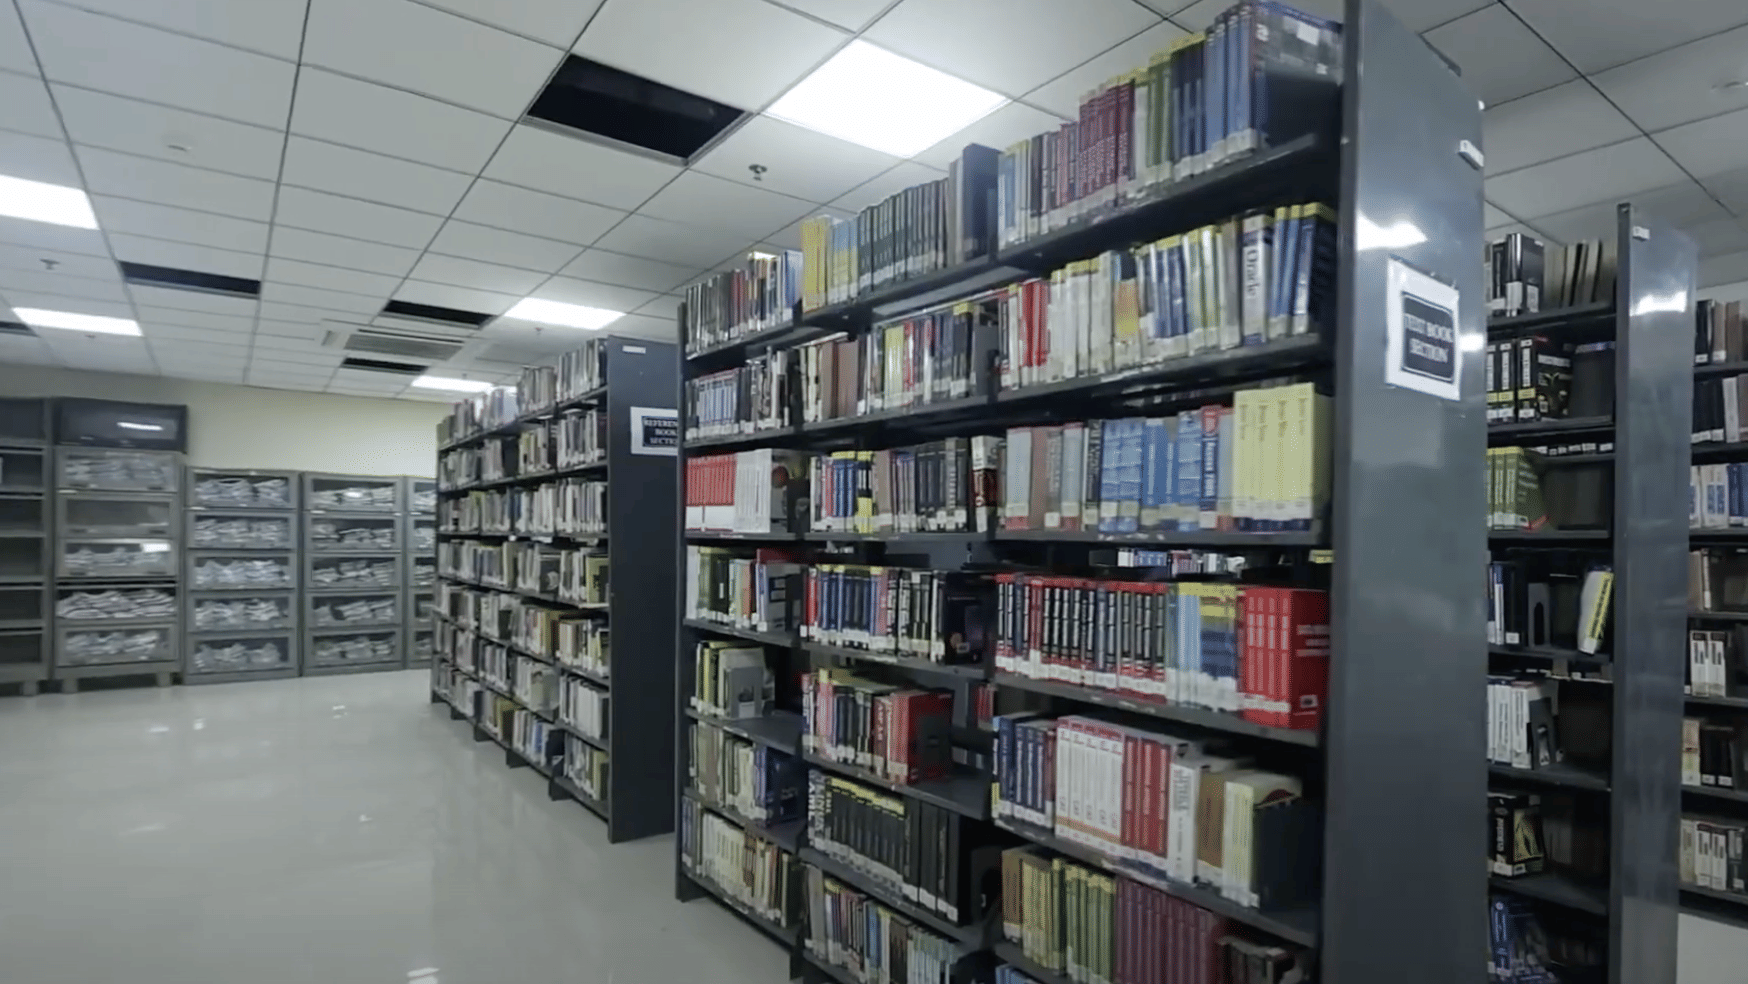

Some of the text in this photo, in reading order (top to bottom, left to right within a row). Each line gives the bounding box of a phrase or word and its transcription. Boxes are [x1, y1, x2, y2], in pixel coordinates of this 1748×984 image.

[1246, 249, 1259, 297] Oracle
[1404, 312, 1454, 343] TEXT BOOK
[1409, 338, 1449, 363] SECTION
